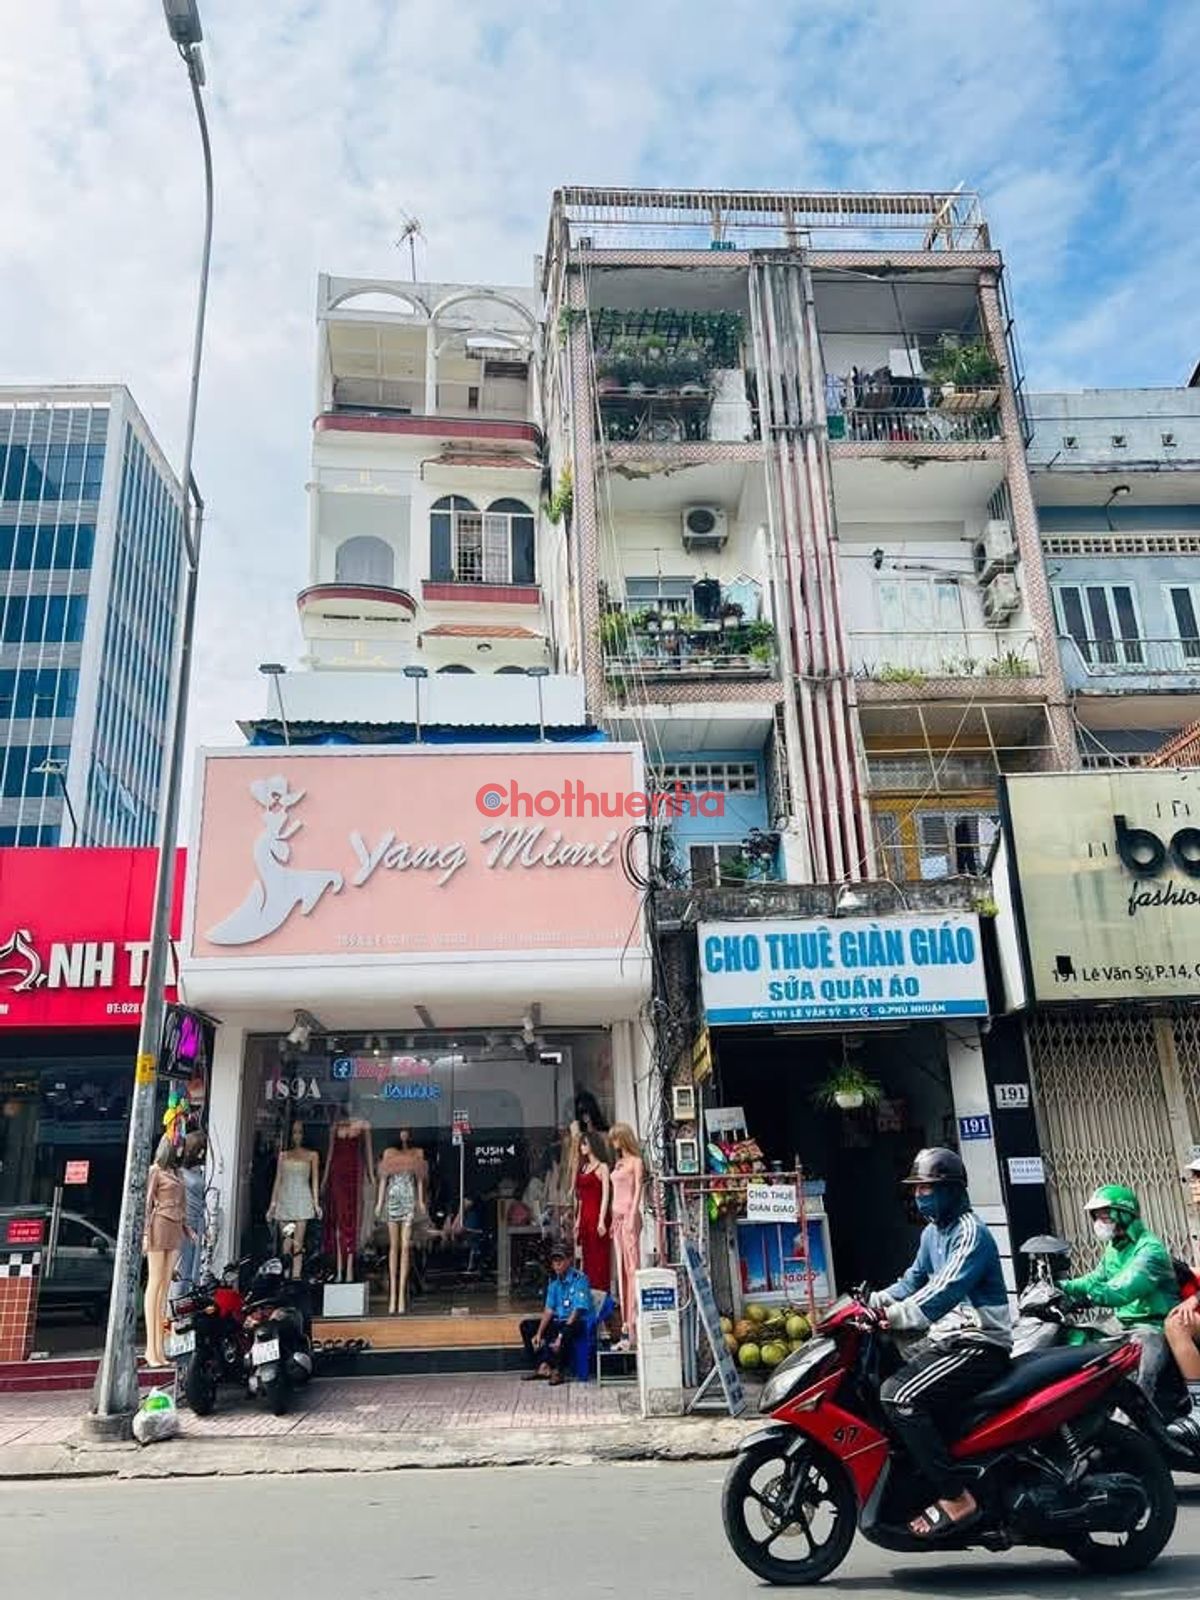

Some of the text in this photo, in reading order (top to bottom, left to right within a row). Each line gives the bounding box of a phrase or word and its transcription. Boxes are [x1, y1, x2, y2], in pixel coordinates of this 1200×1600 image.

[349, 823, 619, 887] Yang Mimi
[1128, 880, 1200, 917] fashio
[704, 920, 976, 973] CHO THUÊ GIÀN GIÁO
[1082, 968, 1100, 982] Lê
[1102, 966, 1132, 981] Văn
[768, 975, 814, 1002] SỬA
[889, 973, 921, 998] ÁO
[999, 1086, 1026, 1101] 191
[962, 1118, 987, 1133] 191
[475, 1146, 504, 1156] PUSH
